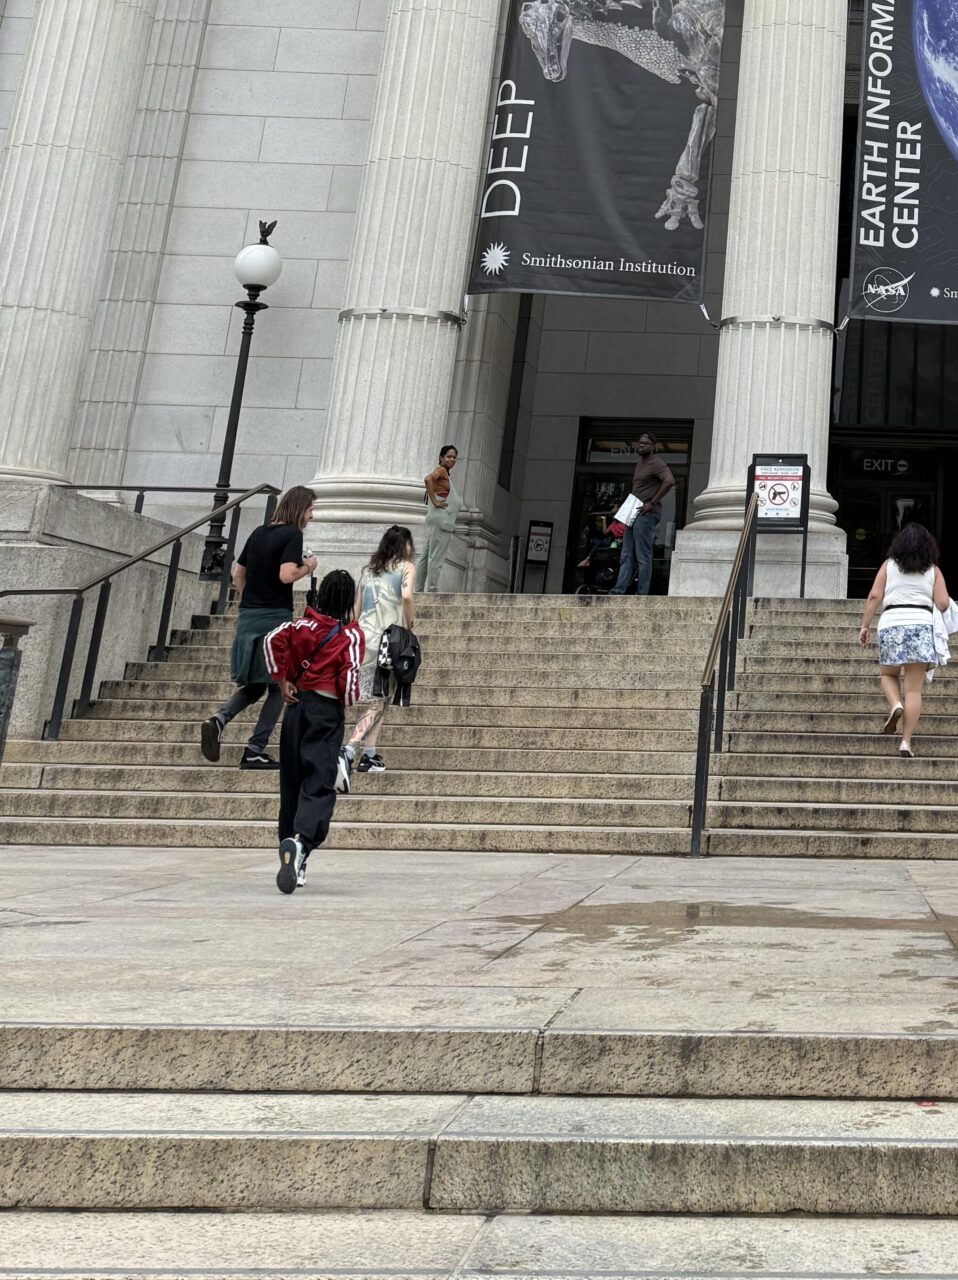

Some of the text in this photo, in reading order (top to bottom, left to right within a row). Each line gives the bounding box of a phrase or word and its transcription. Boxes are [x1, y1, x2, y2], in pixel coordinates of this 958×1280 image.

[480, 79, 535, 218] DEEP
[859, 140, 889, 247] EARTH
[891, 121, 922, 249] CENTER
[521, 252, 696, 277] Smithsonian Institution
[867, 283, 906, 296] NASA
[611, 447, 640, 458] ENT
[863, 458, 895, 471] EXIT
